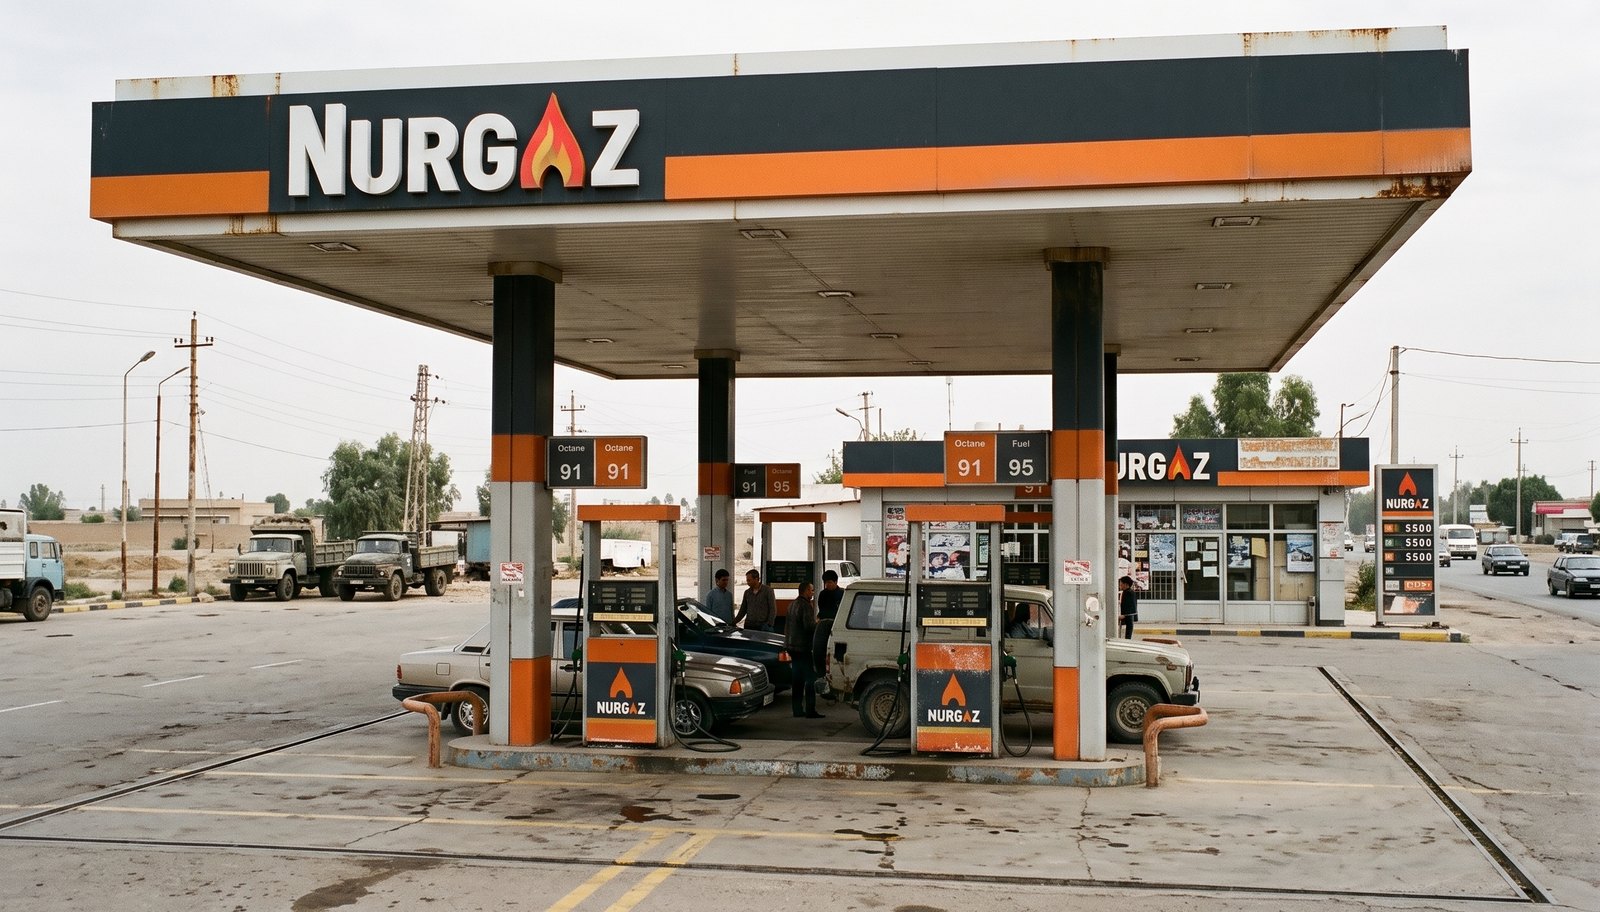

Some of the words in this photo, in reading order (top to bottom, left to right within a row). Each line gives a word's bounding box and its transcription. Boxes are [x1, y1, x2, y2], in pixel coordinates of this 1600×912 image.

[288, 92, 640, 198] NURGAZ
[558, 444, 585, 452] Octane
[604, 444, 634, 452] Octane
[954, 440, 985, 448] Octane
[1012, 440, 1030, 448] Fuel
[560, 463, 581, 480] 91
[607, 463, 629, 480] 91
[958, 459, 980, 477] 91
[1008, 459, 1034, 477] 95
[742, 481, 757, 493] 91
[773, 480, 790, 493] 95
[1386, 498, 1429, 509] NURGAZ
[596, 701, 646, 715] NURGAZ
[927, 708, 981, 723] NURGAZ
